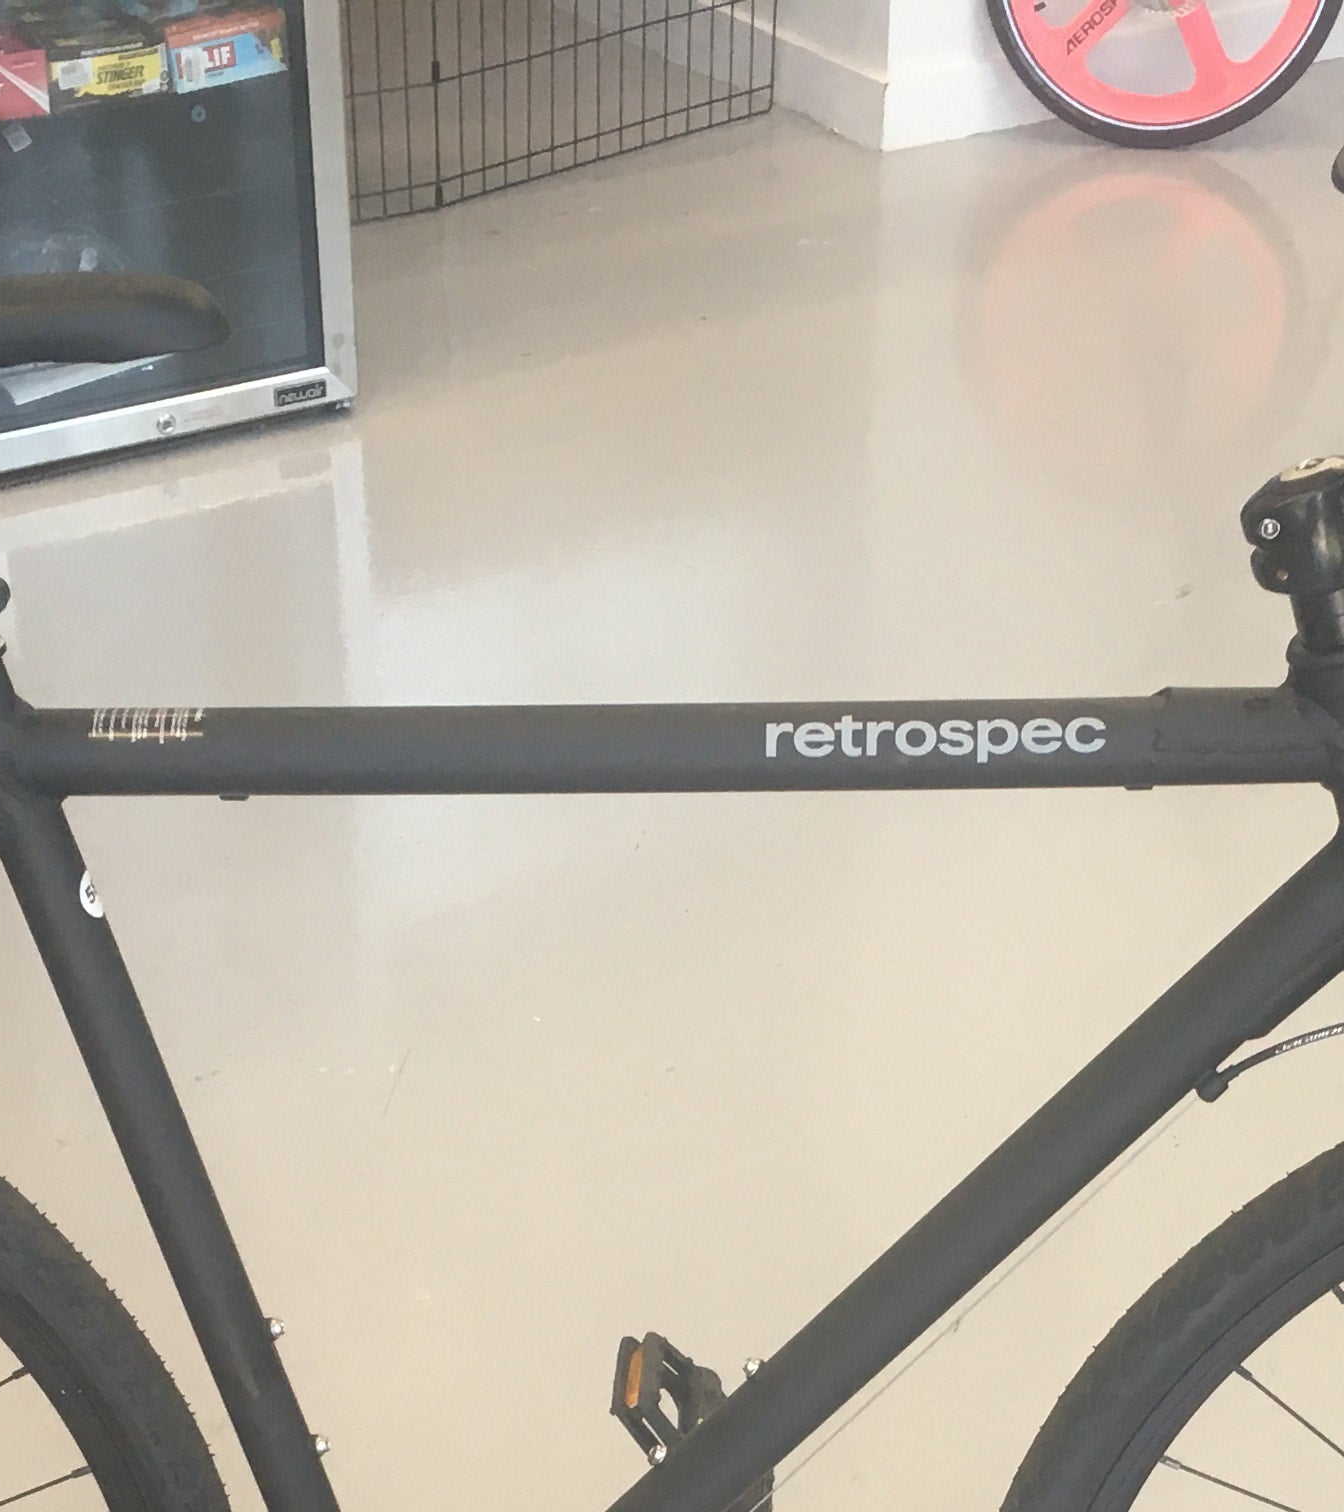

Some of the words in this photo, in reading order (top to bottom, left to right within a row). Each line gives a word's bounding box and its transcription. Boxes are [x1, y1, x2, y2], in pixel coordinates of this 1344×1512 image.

[97, 64, 145, 85] STINGER
[278, 383, 324, 404] newair
[765, 714, 1107, 764] retrospec
